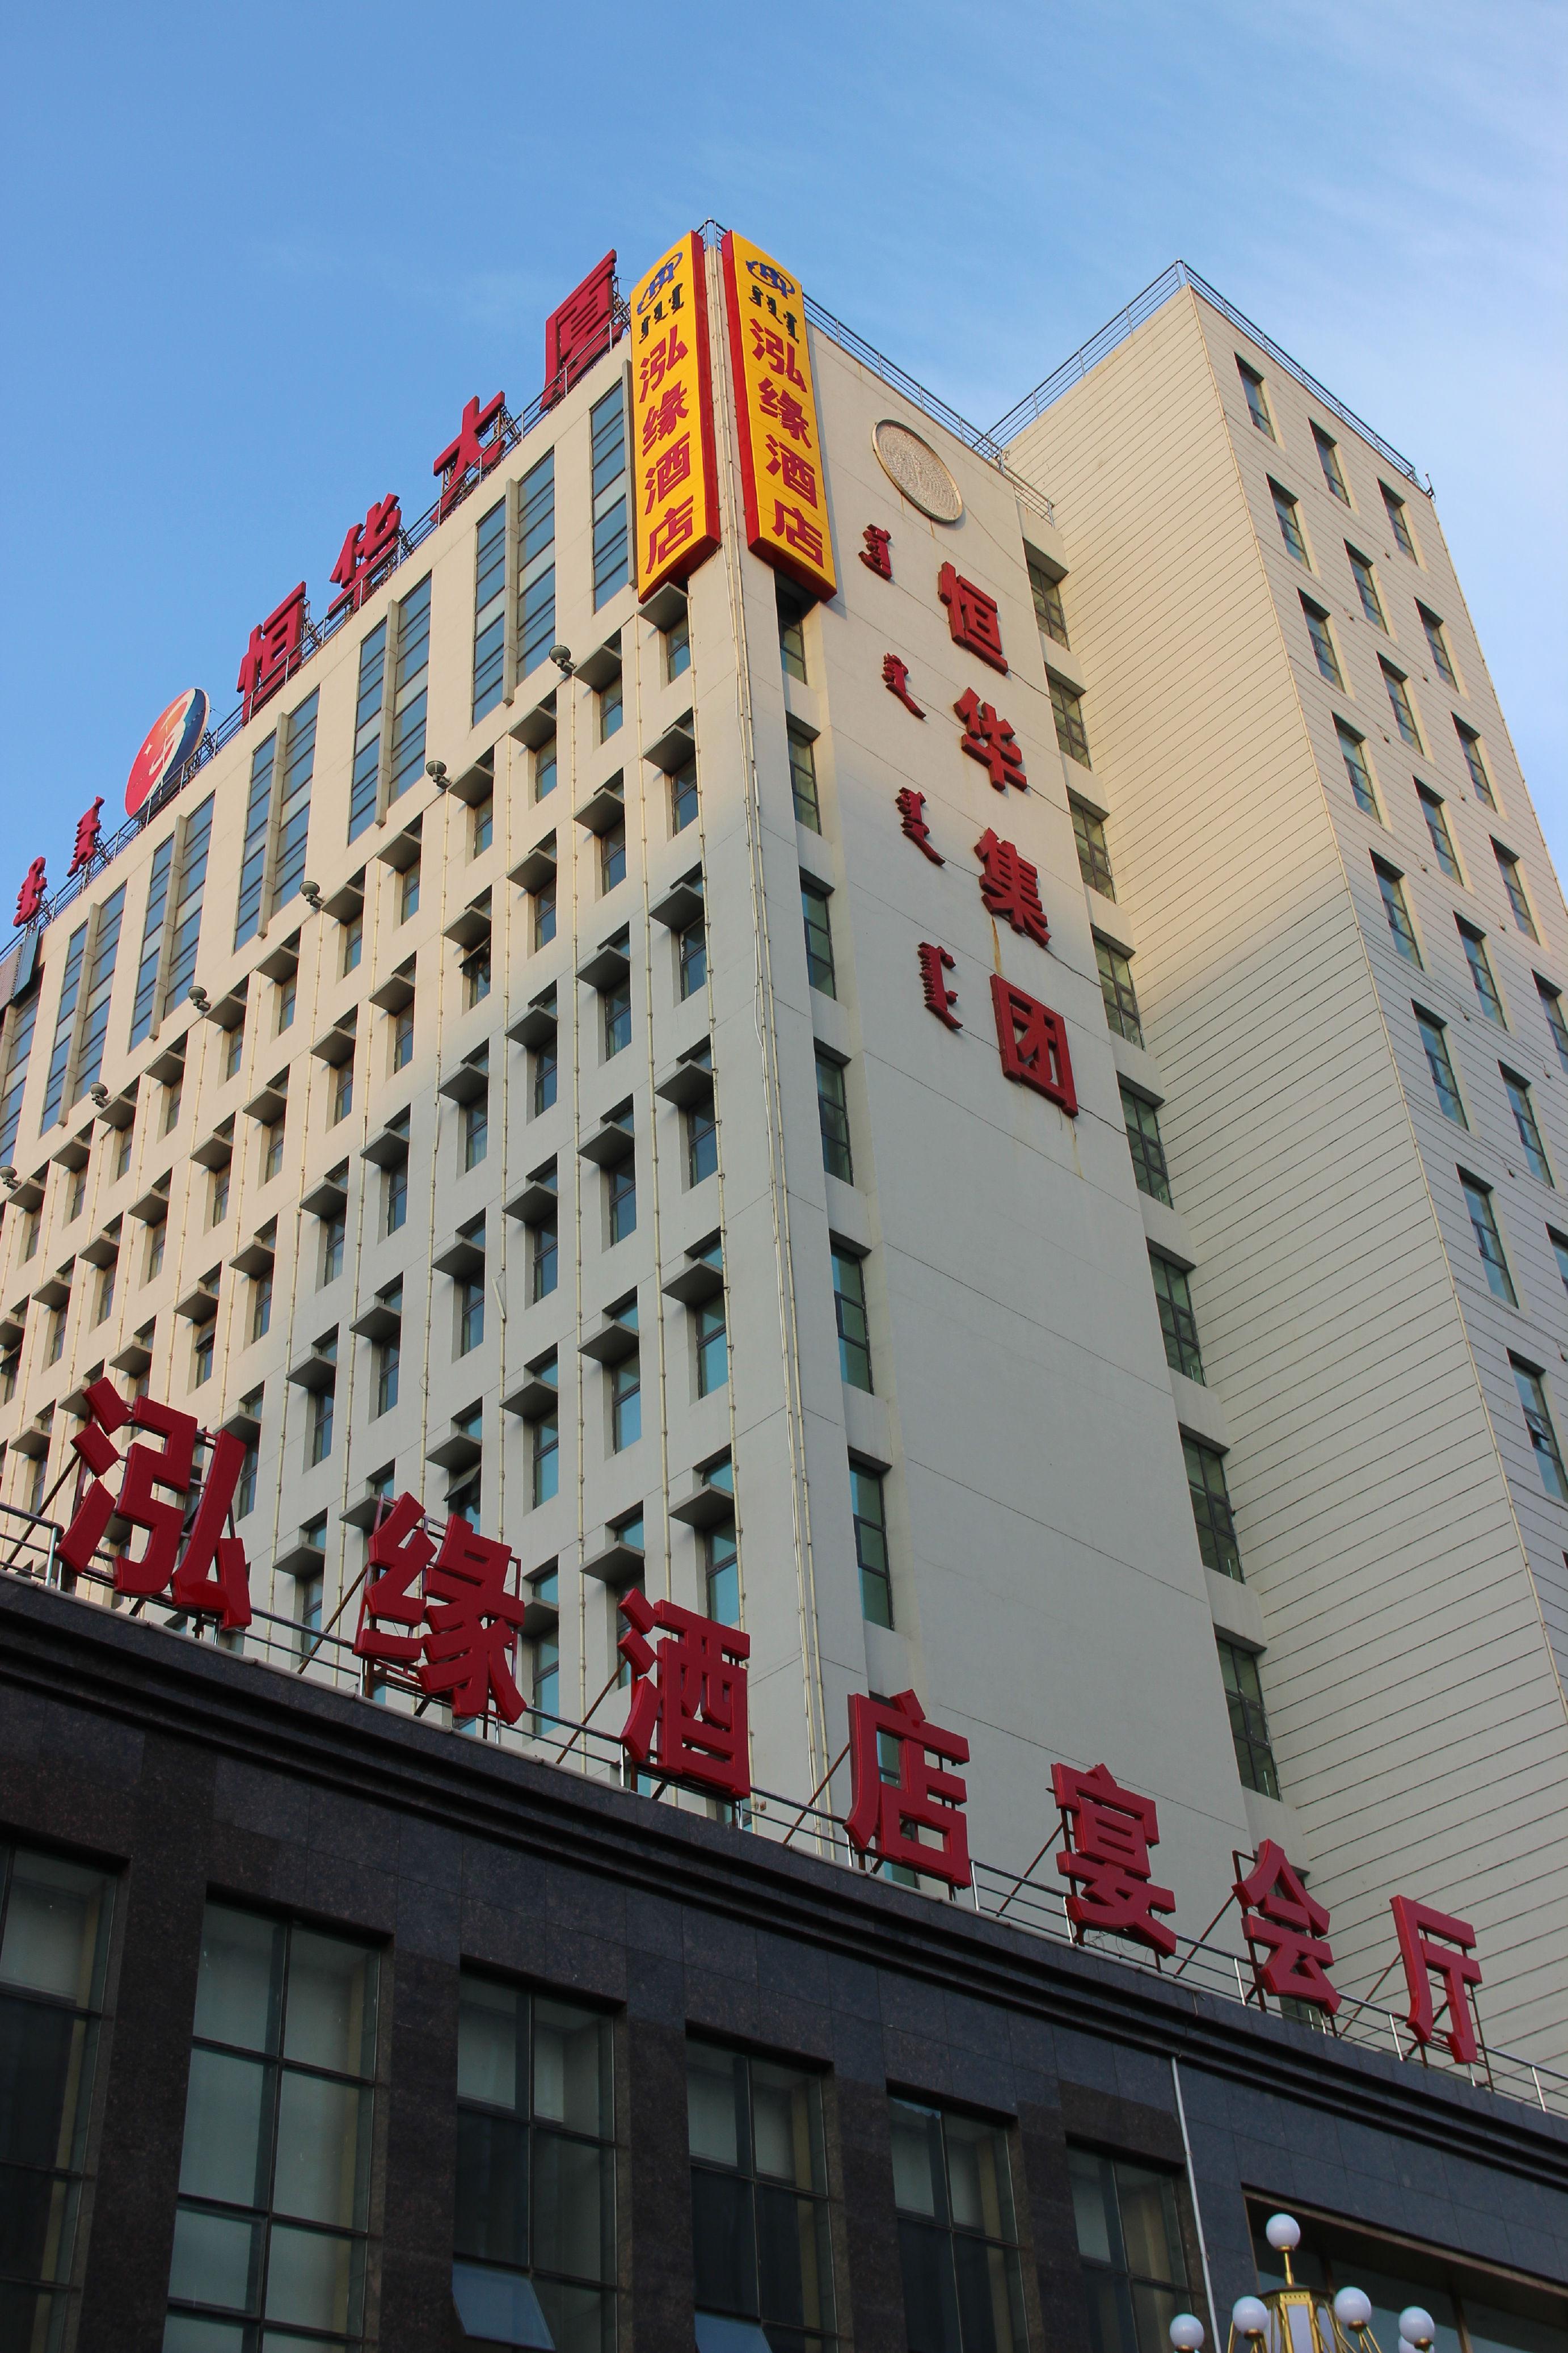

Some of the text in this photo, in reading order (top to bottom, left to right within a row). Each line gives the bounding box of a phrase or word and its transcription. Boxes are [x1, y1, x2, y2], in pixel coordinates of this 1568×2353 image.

[237, 249, 623, 726] 恒华大厦
[639, 324, 693, 574] 泓缘酒店
[749, 318, 824, 569] 泓缘酒店
[938, 561, 1078, 1118] 恒华集团
